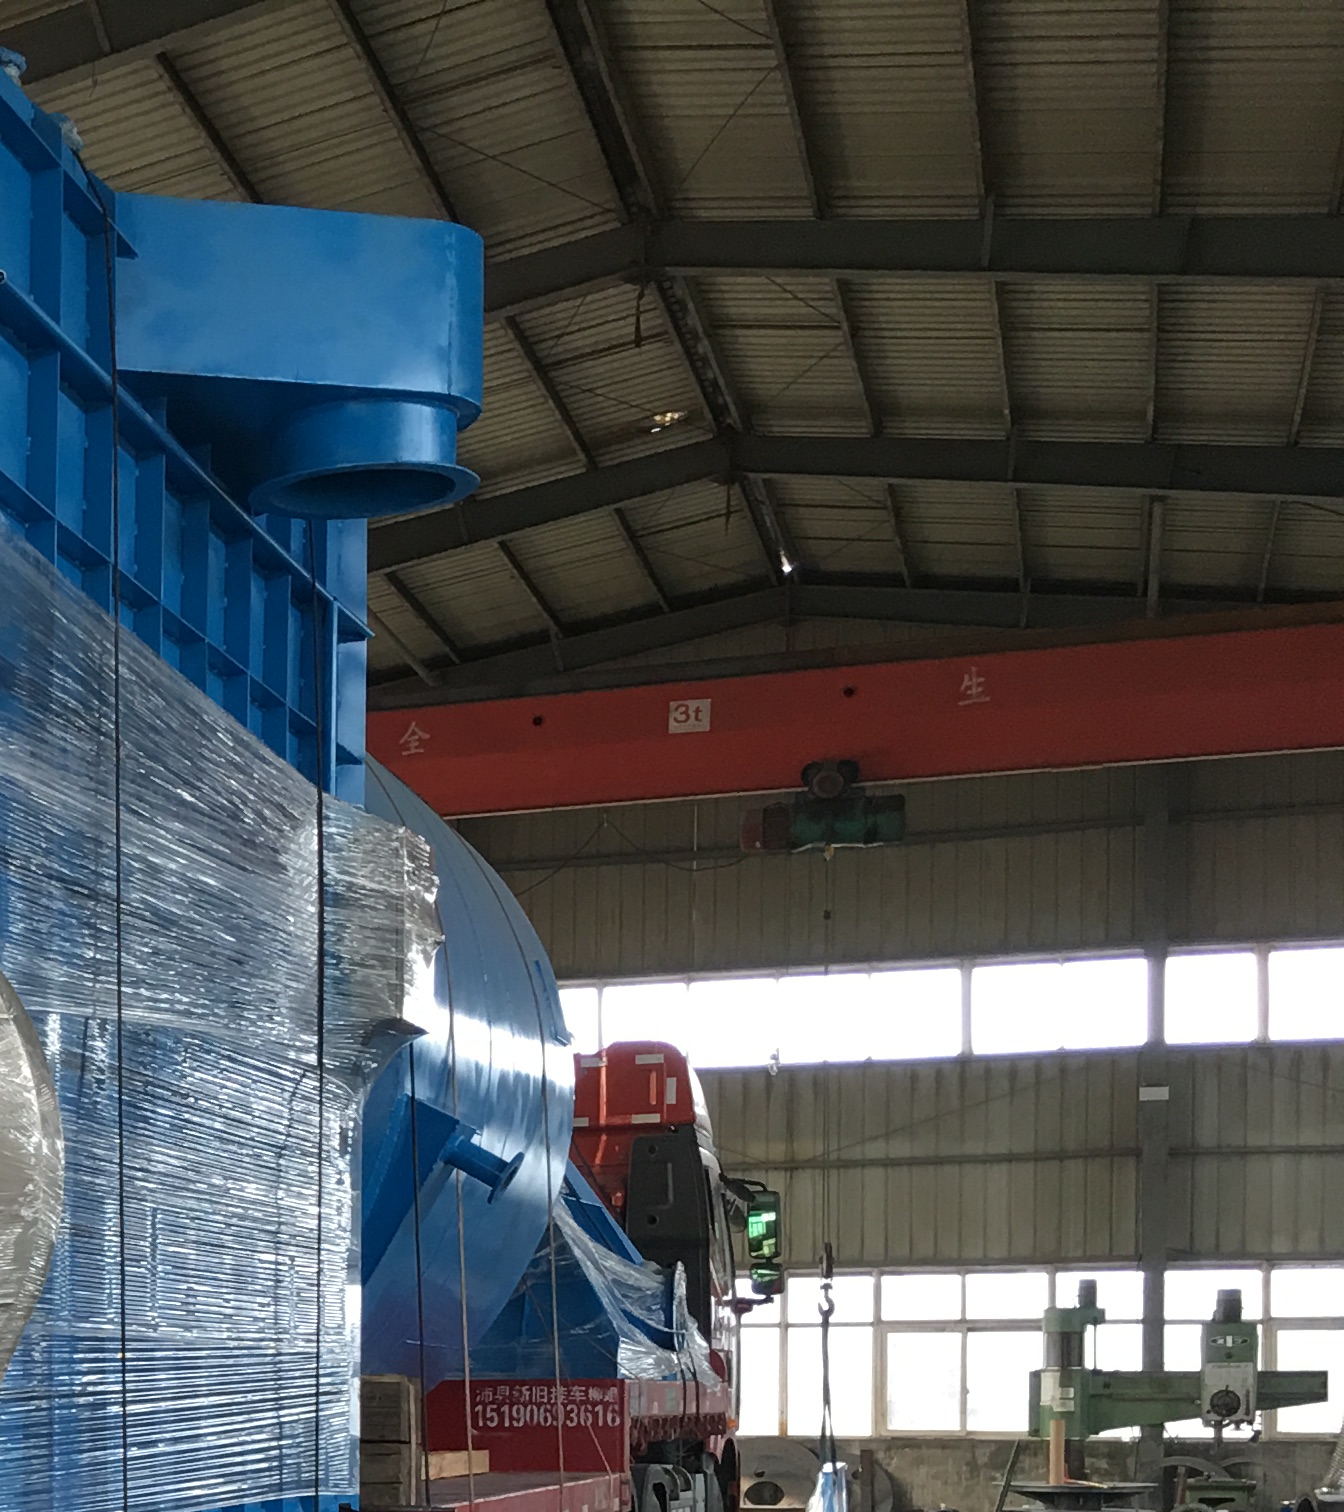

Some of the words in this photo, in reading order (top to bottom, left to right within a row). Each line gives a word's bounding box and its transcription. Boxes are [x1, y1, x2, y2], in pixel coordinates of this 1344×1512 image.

[399, 721, 431, 756] 全
[957, 666, 991, 706] 生
[673, 703, 703, 724] 3t
